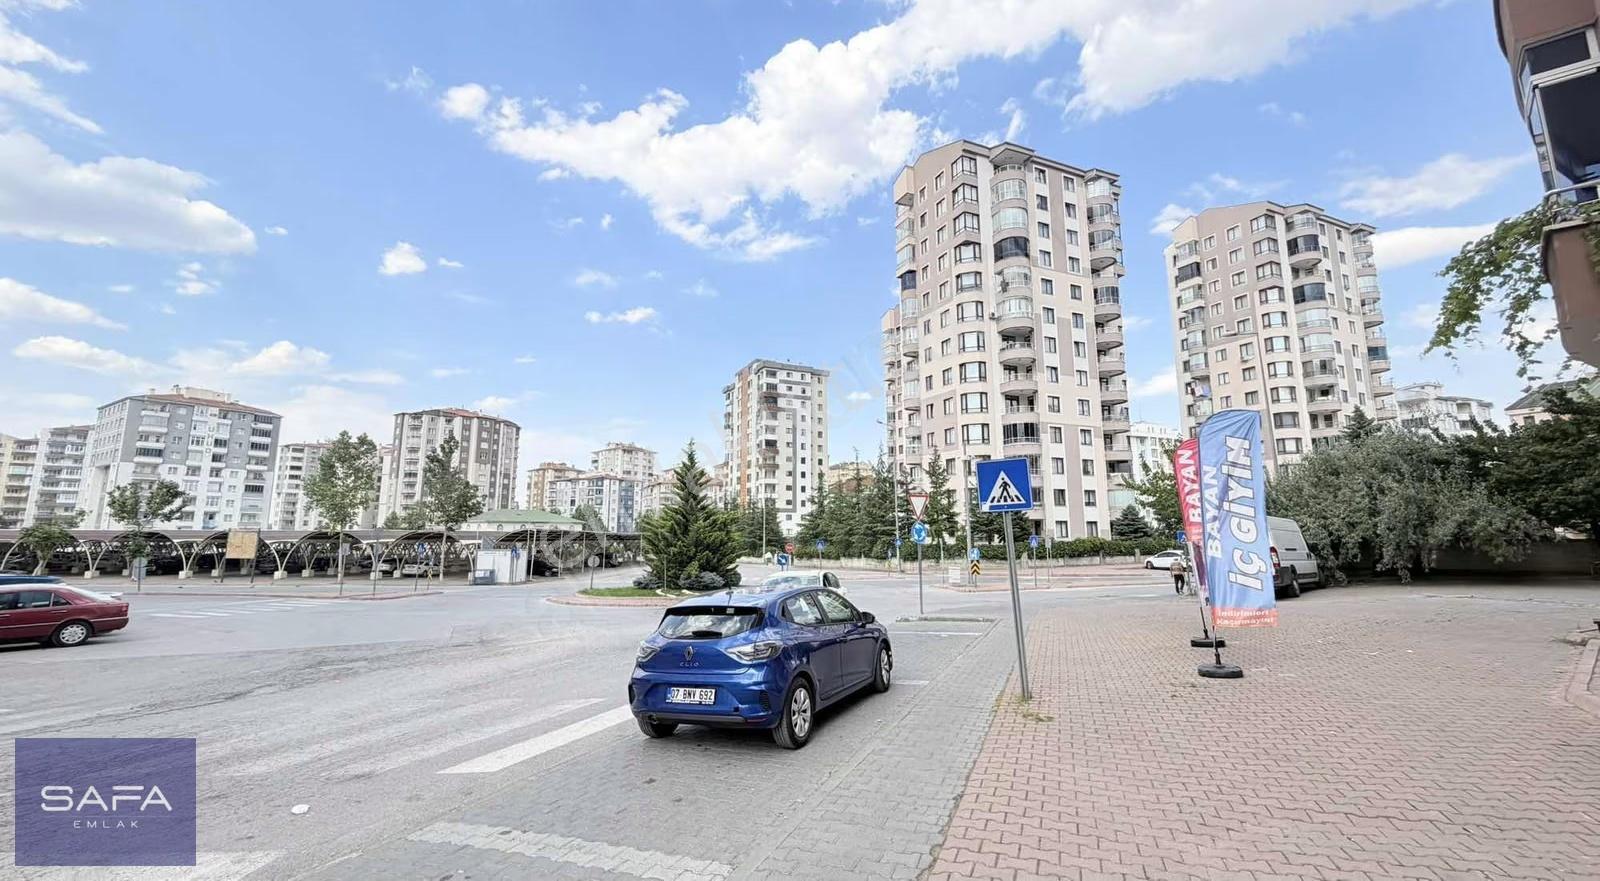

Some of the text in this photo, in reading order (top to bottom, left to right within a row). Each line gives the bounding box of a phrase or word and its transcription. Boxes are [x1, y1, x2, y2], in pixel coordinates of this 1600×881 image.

[1178, 449, 1202, 524] BAYAN
[1203, 465, 1222, 558] BAYAN
[1221, 435, 1268, 591] İÇ GİYİM
[671, 688, 713, 700] 07 BNV 692
